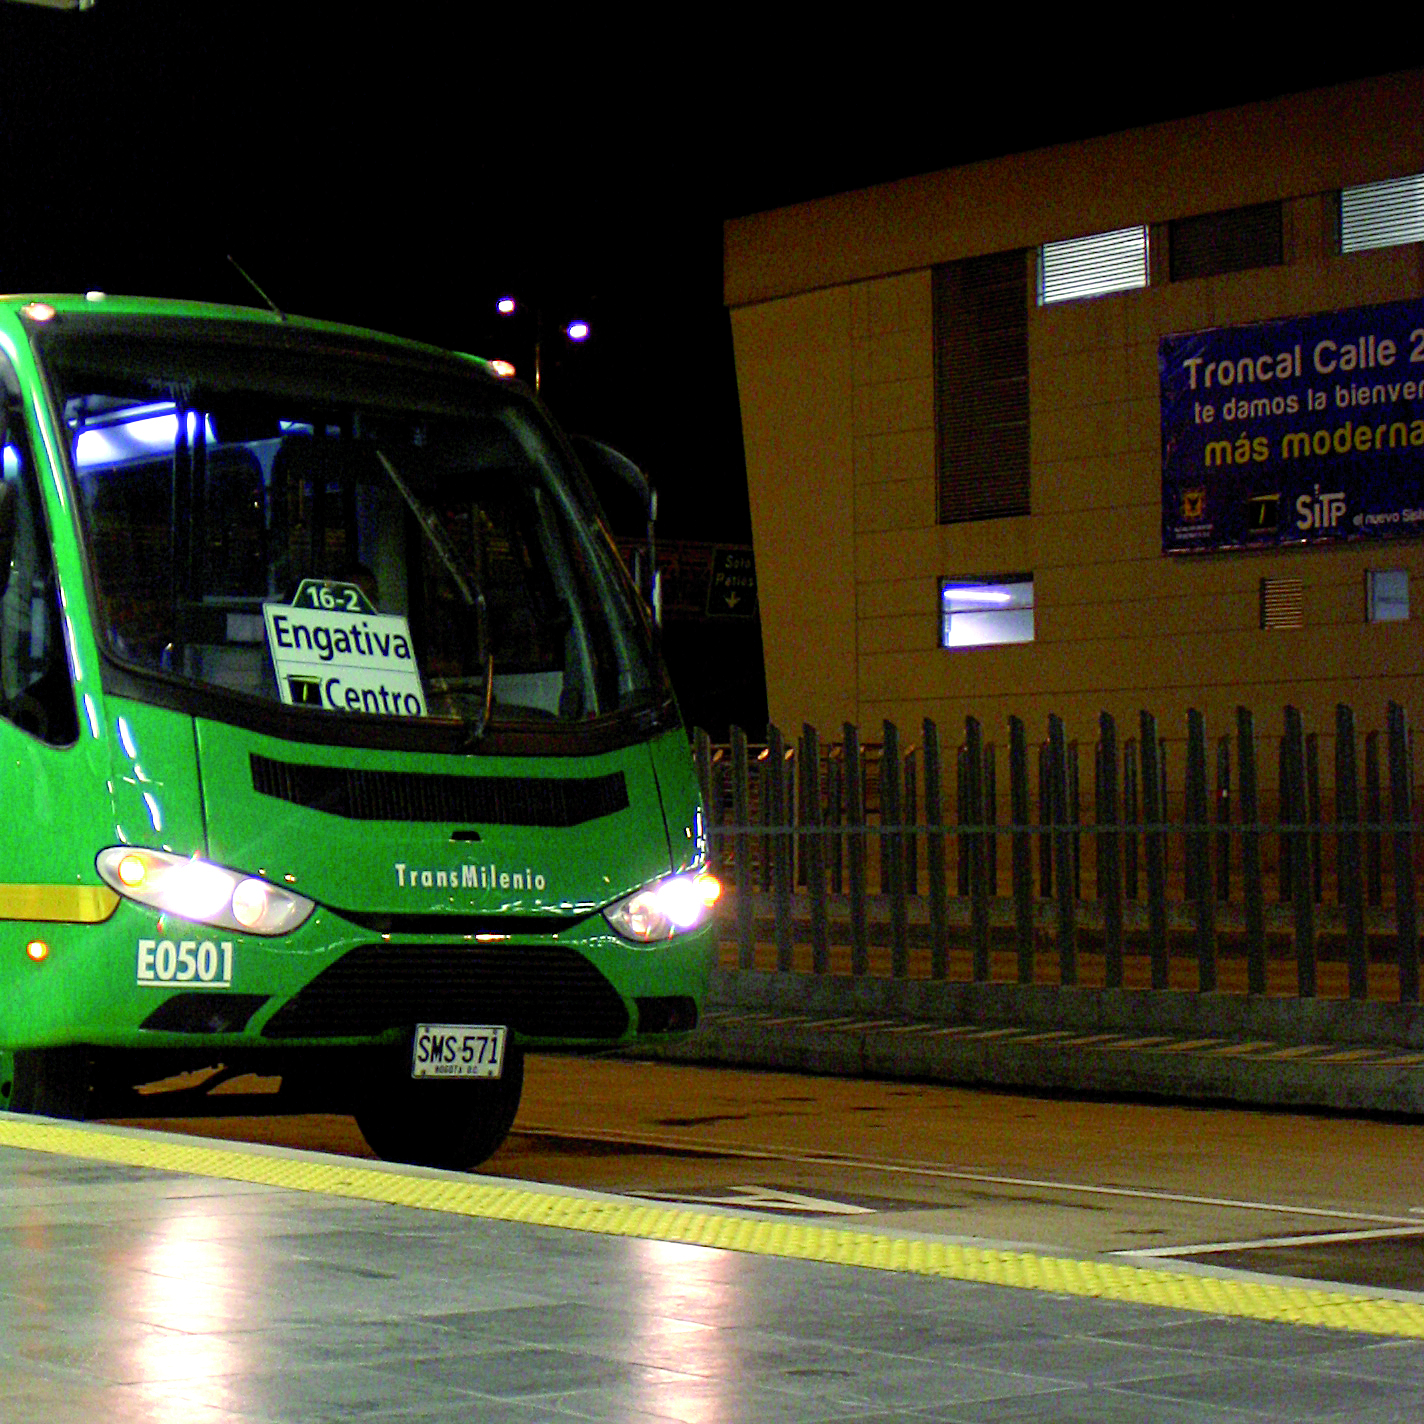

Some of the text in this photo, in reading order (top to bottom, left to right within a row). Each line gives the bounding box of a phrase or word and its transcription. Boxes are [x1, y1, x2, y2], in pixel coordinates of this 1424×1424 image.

[1183, 344, 1303, 390] Troncal
[1313, 334, 1397, 374] Calle
[1194, 401, 1215, 424] te
[1223, 394, 1299, 421] damos
[1308, 389, 1326, 411] la
[1204, 431, 1269, 466] más
[306, 585, 361, 612] 16-2
[272, 614, 412, 661] Engativa
[326, 678, 422, 716] Centro
[395, 863, 546, 891] TransMilenio
[137, 939, 233, 981] E0501
